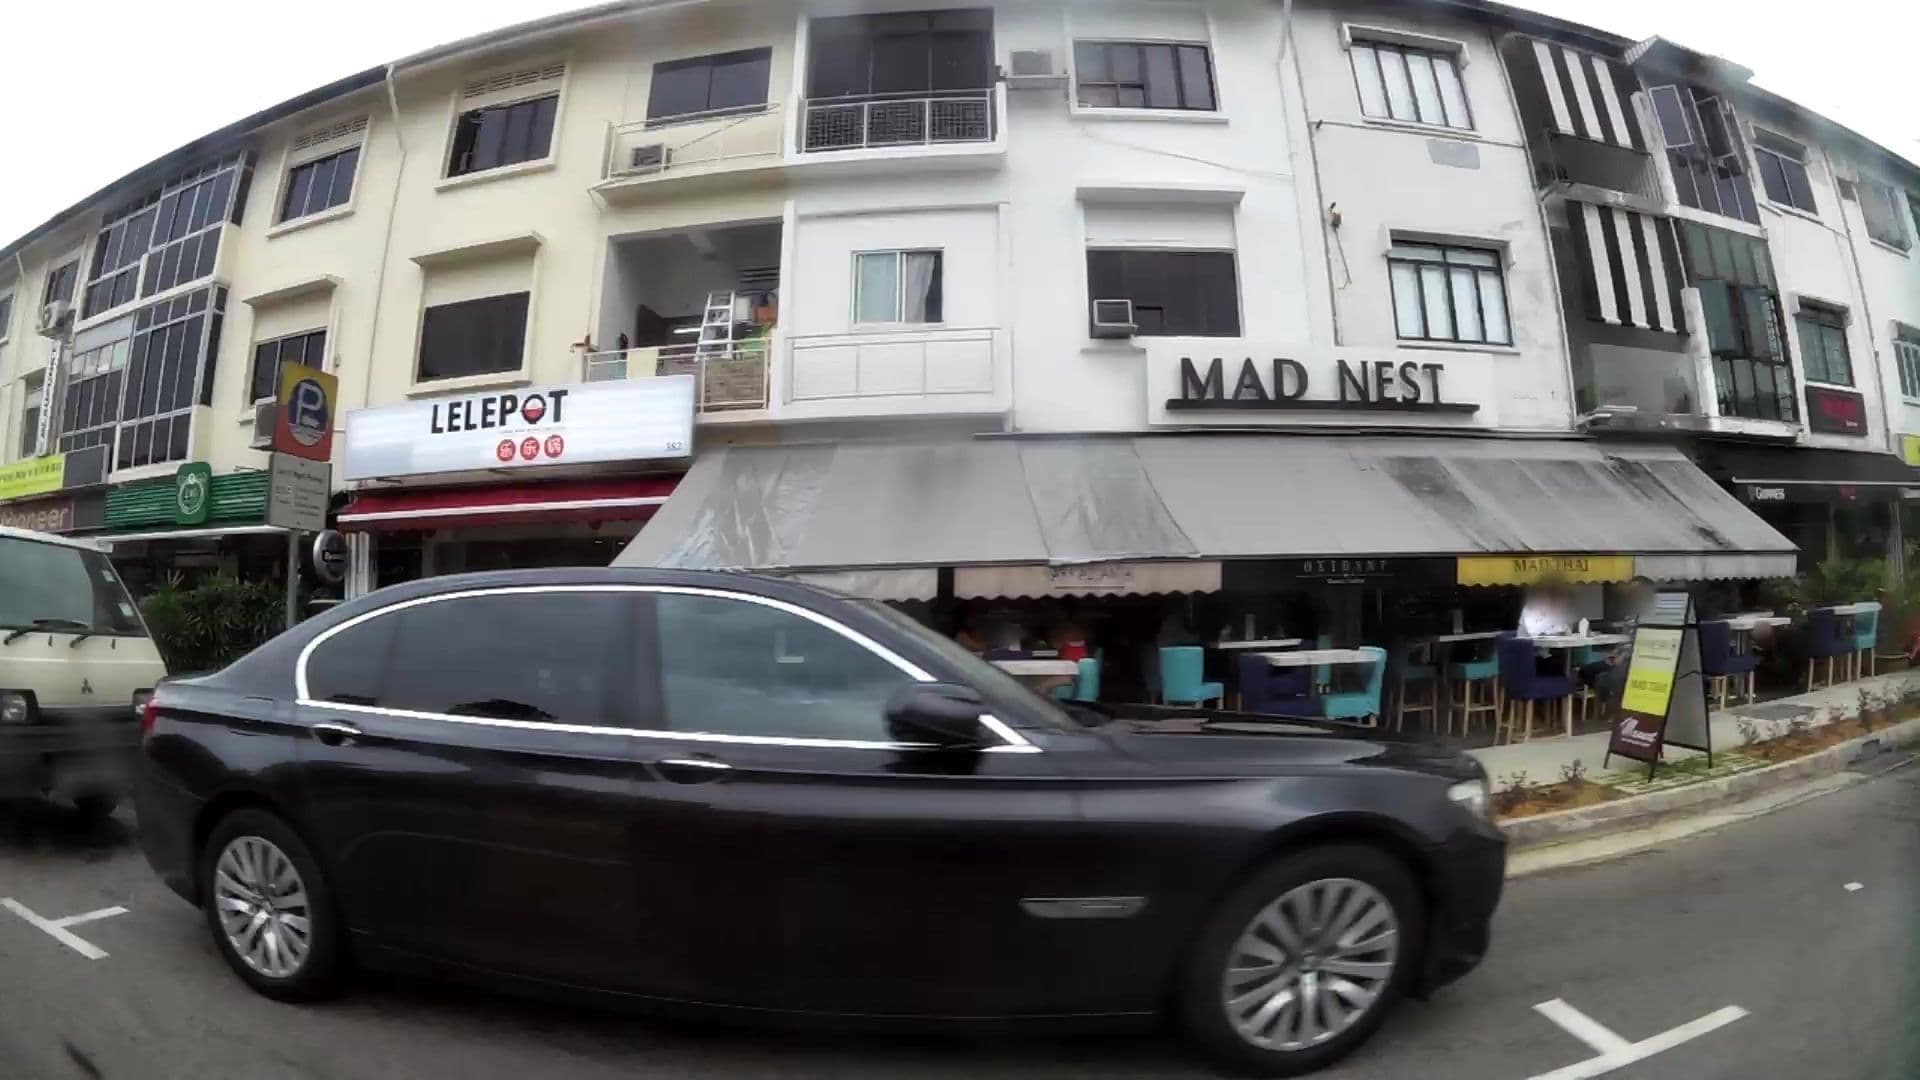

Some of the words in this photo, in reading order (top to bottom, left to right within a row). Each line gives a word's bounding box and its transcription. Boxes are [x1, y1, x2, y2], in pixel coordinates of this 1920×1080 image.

[1180, 357, 1309, 401] MAD
[1336, 359, 1444, 403] NEST
[431, 389, 568, 434] LELEPOT
